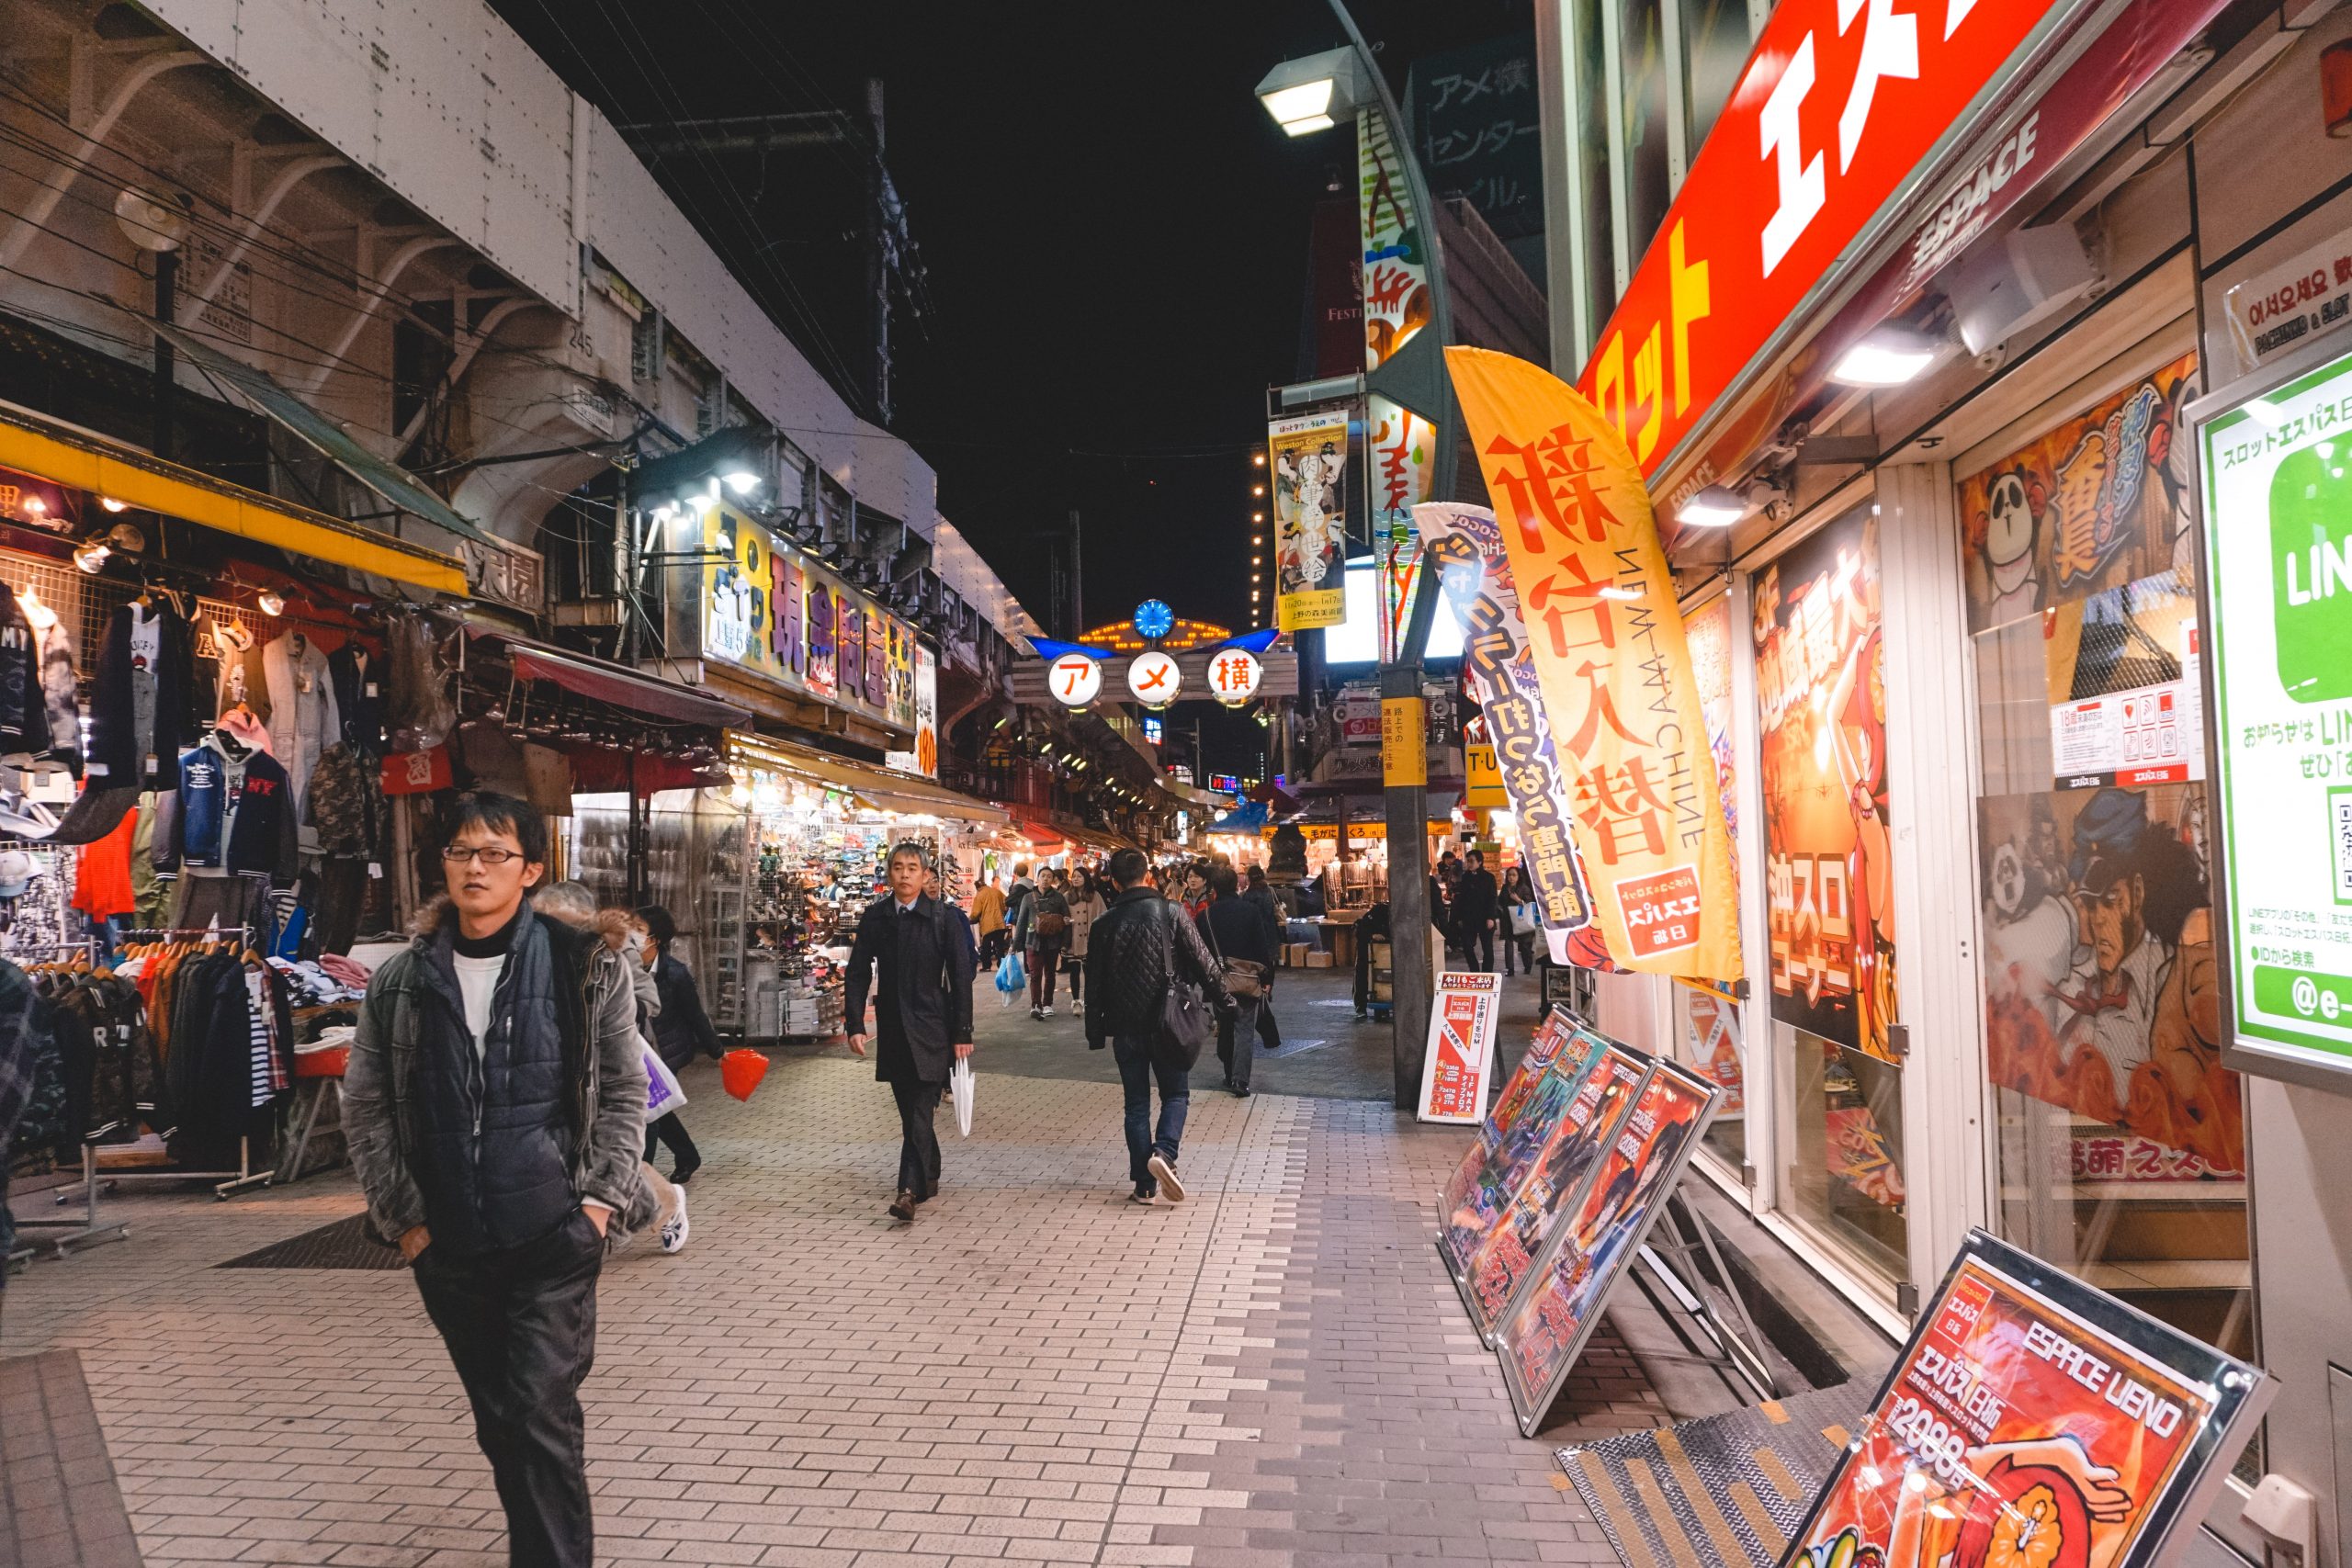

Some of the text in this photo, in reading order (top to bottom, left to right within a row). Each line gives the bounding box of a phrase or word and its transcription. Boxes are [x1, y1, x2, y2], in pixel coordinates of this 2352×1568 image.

[1431, 60, 1530, 111] アメ横
[1913, 110, 2040, 270] ESPACE
[2248, 268, 2328, 327] 어서오세요
[2255, 313, 2309, 356] PACHINKO
[2321, 292, 2350, 324] SLOT
[570, 326, 593, 357] 245
[1582, 216, 1711, 467] ロット
[1276, 438, 1305, 451] Weston
[1306, 433, 1343, 446] Collection
[1754, 563, 1780, 642] 3F
[197, 632, 218, 659] A
[1059, 658, 1251, 695] アメ横
[1384, 708, 1394, 771] 違法販売に注意
[1394, 707, 1403, 742] 路上での
[1311, 829, 1337, 838] 毛がに
[1769, 852, 1849, 942] 沖スロ
[1444, 976, 1493, 985] 本日もご来店
[1772, 942, 1849, 1002] コーナー
[1948, 1296, 1979, 1325] エスパス
[1915, 1345, 2007, 1431] エスパス日拓
[2022, 1320, 2183, 1439] ESPACE UENO
